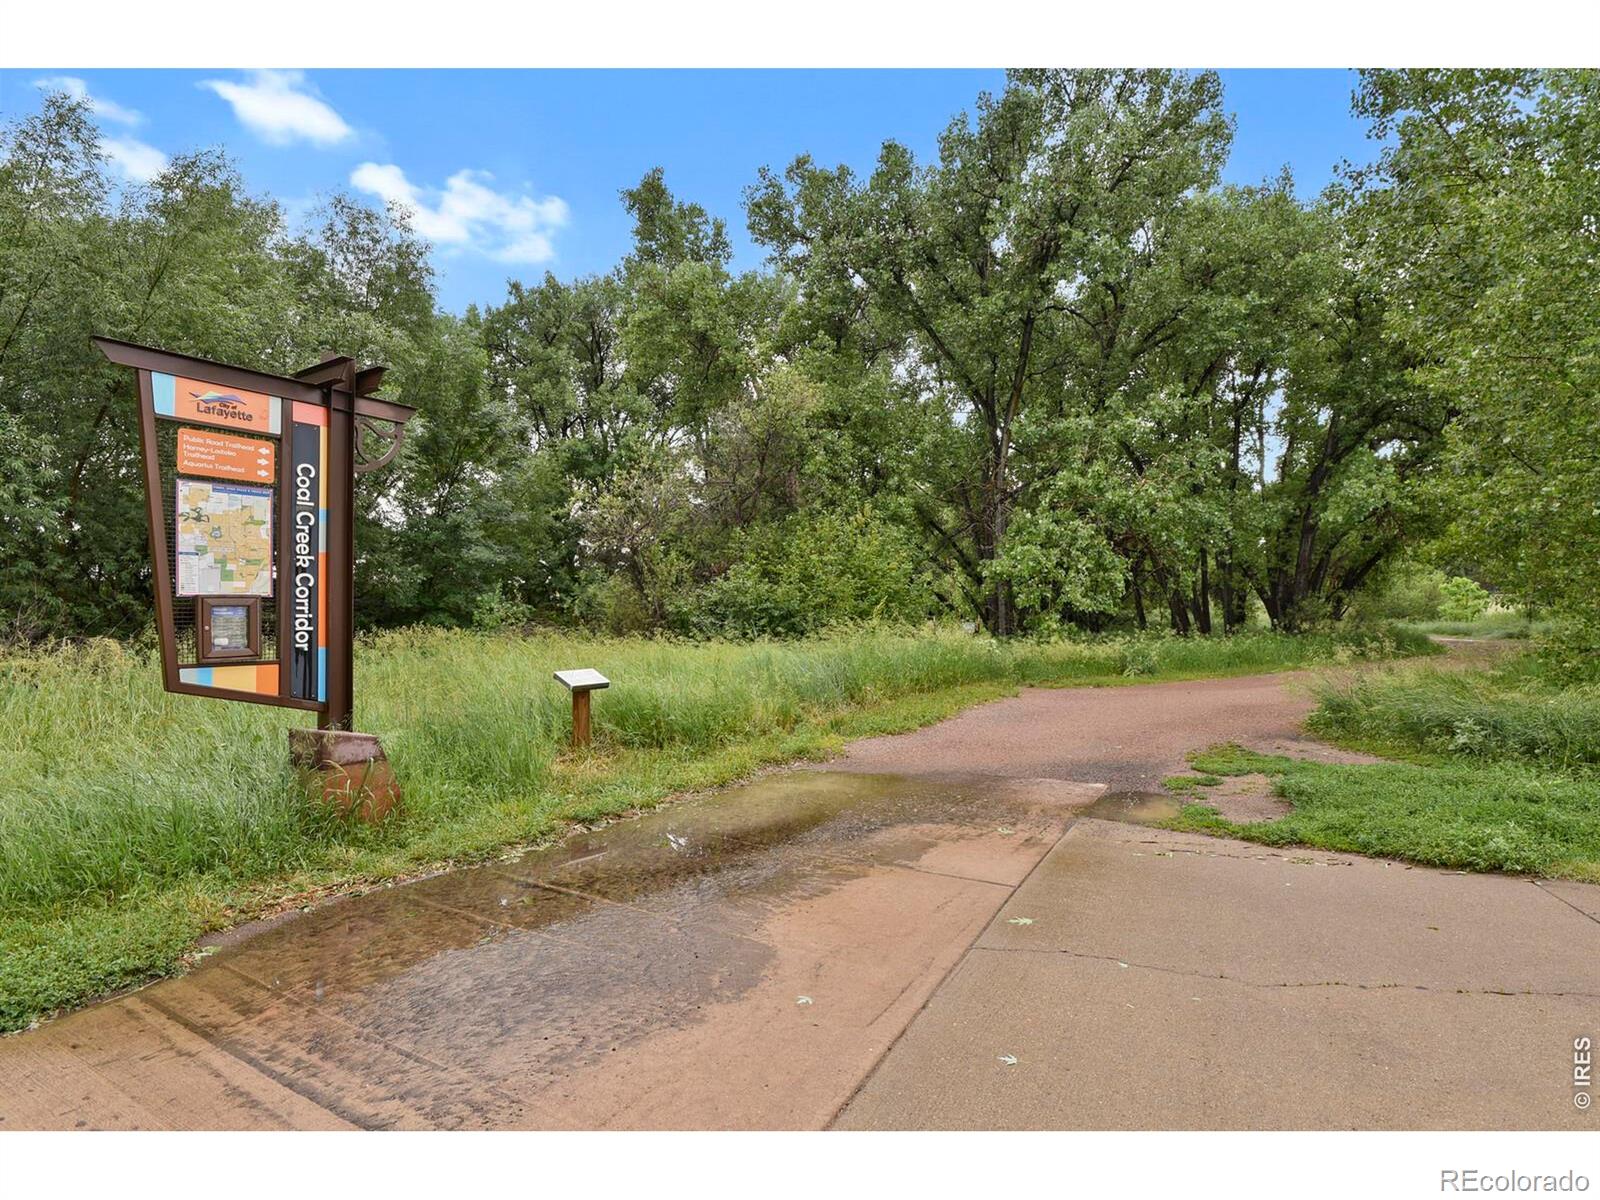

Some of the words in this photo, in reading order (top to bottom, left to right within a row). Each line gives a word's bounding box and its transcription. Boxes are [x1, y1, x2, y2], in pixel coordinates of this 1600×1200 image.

[196, 402, 253, 421] Lafayette
[219, 402, 231, 410] City
[183, 434, 205, 444] Public
[206, 438, 224, 447] Road
[225, 441, 256, 452] Trailhead
[183, 450, 215, 461] Trailhead
[183, 460, 213, 470] Aquarius
[215, 463, 245, 473] Trailhead
[296, 463, 316, 506] Coal
[295, 511, 315, 568] Creek
[294, 573, 315, 652] Corridor
